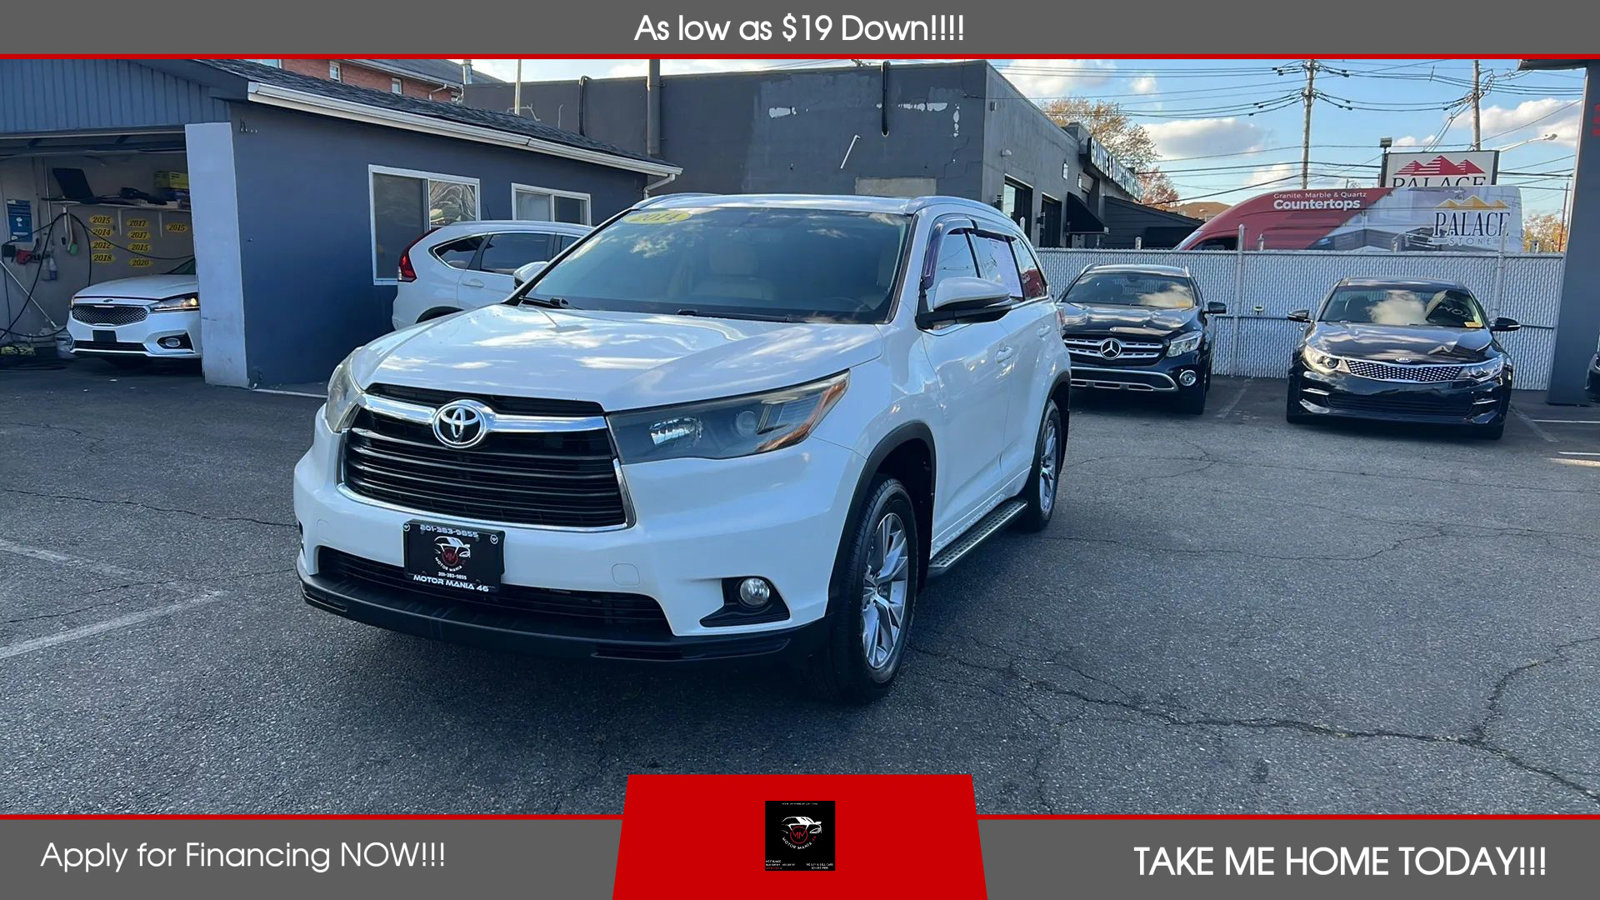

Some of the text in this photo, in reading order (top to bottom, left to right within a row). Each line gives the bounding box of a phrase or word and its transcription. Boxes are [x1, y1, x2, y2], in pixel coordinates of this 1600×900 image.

[1273, 199, 1361, 211] Countertops
[92, 215, 111, 224] 2015
[1433, 211, 1511, 237] PALACE
[130, 231, 147, 239] 2017
[1448, 237, 1492, 246] STONE
[413, 574, 444, 585] MOTOR
[445, 579, 475, 590] MANIA
